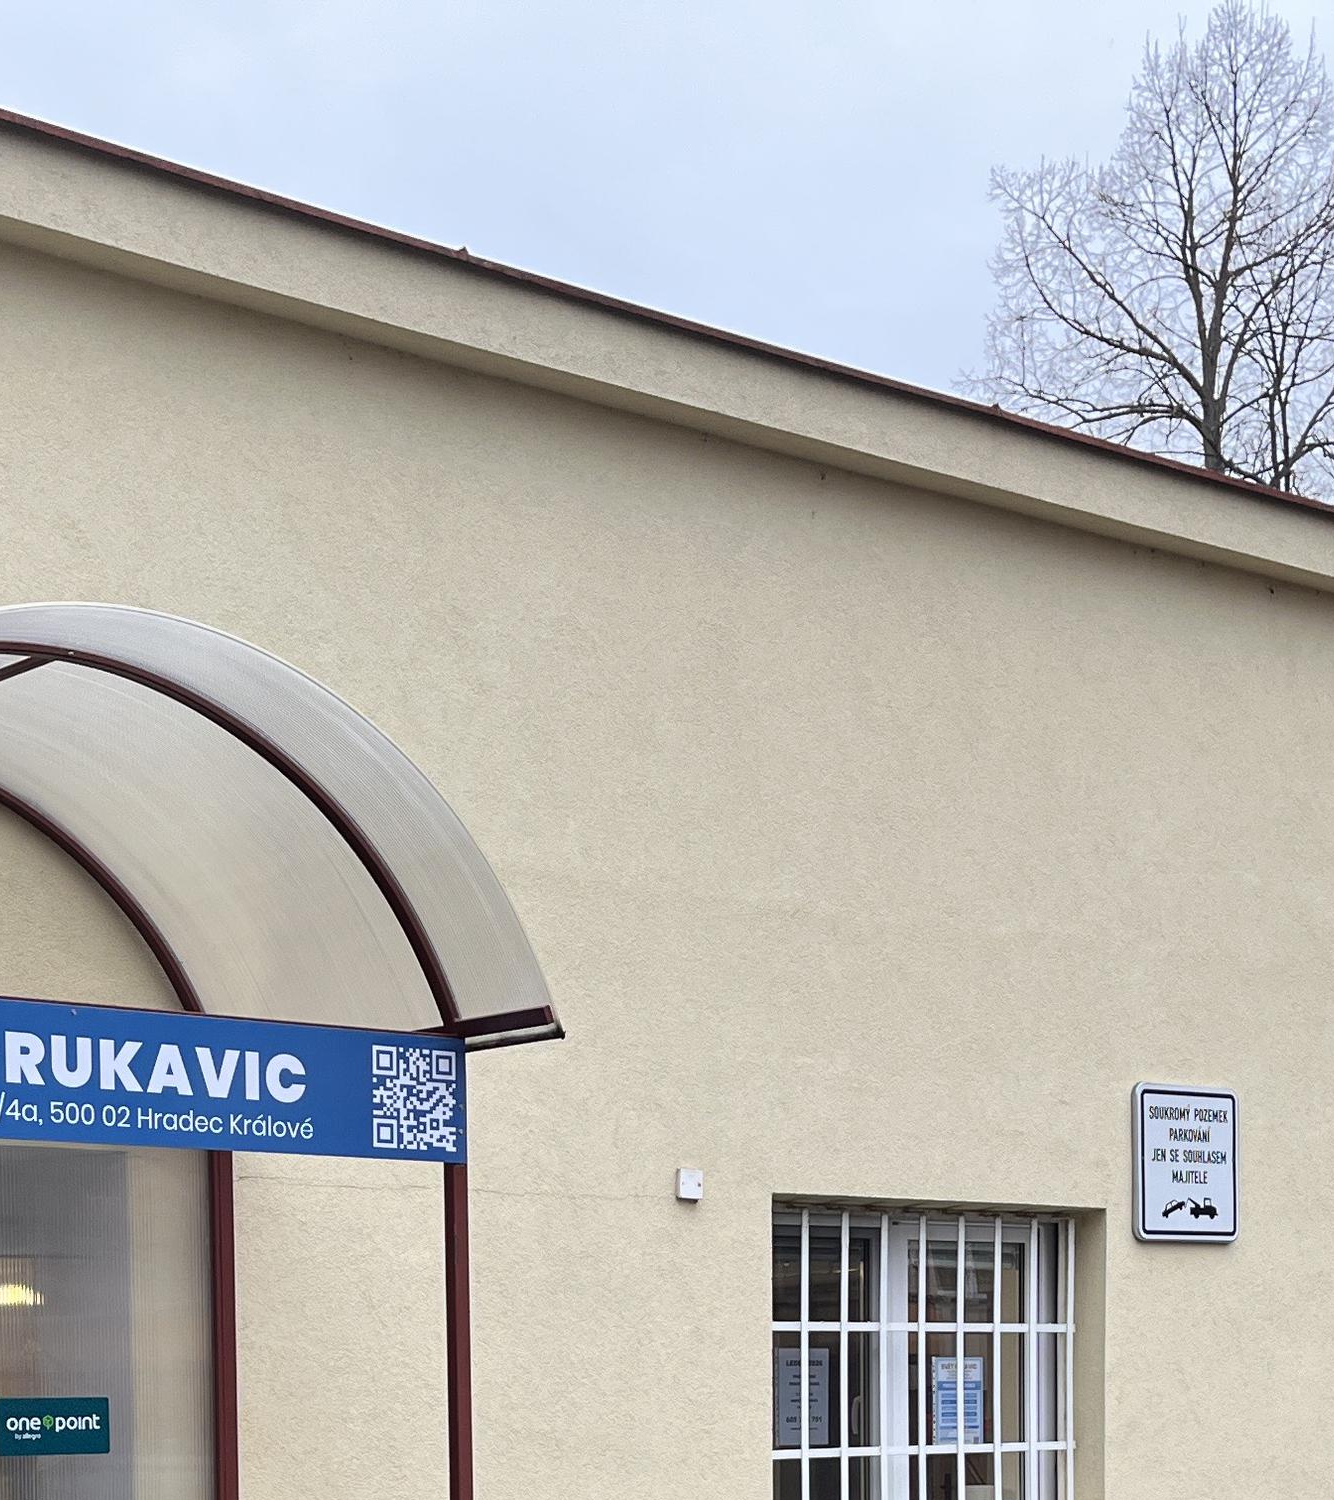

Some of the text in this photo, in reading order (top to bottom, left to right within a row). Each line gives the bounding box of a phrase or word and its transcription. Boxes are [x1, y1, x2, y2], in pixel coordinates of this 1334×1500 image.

[4, 1030, 307, 1104] RUKAVIC
[50, 1101, 95, 1125] 500
[102, 1104, 131, 1128] 02
[137, 1107, 223, 1134] Hradec
[230, 1113, 314, 1140] Králové
[1148, 1104, 1228, 1123] SOUKROMÝ POZEMEK
[1168, 1126, 1211, 1143] PARKOVÁNÍ
[1151, 1148, 1227, 1165] JEN SE SOUHLASEM
[1171, 1169, 1208, 1185] MAJITELE
[6, 1413, 101, 1433] one point
